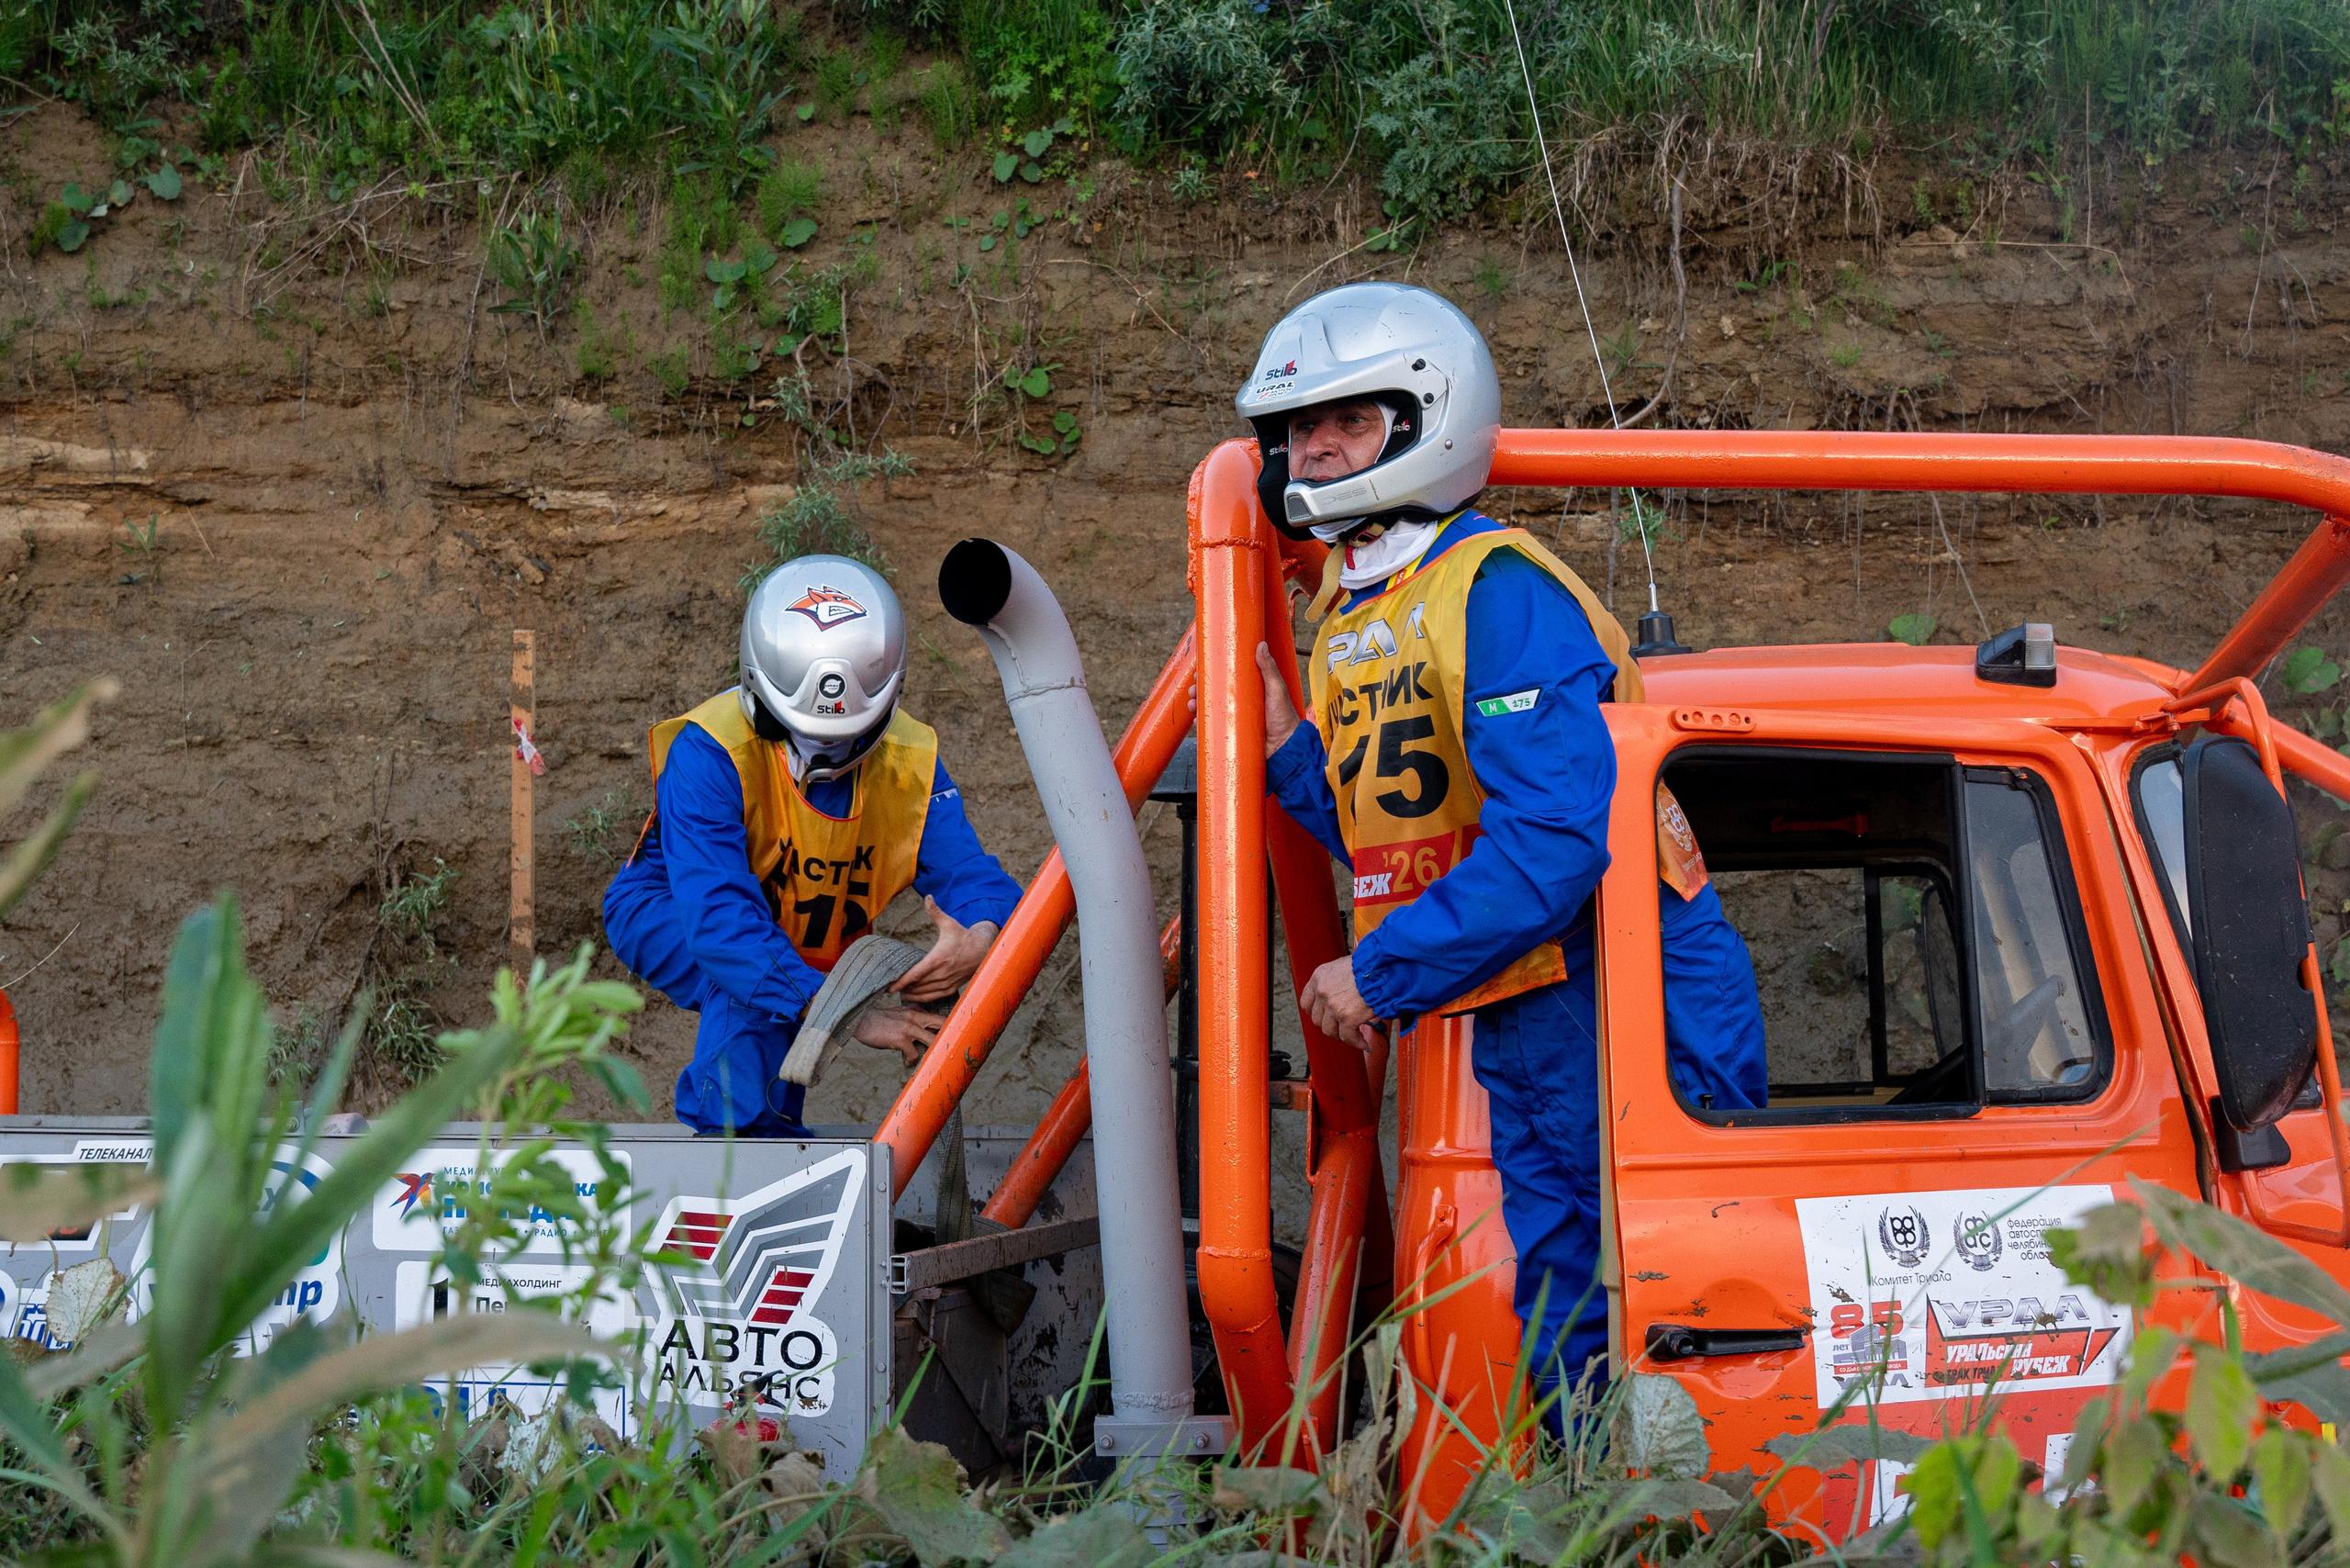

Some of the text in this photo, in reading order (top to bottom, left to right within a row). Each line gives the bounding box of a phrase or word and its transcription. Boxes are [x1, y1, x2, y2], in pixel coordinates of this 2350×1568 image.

[1265, 360, 1297, 380] Stilo
[1257, 382, 1293, 394] URAL
[1327, 601, 1426, 676] РАЛ
[817, 700, 845, 714] Stilo
[1512, 699, 1531, 708] 175
[79, 1148, 153, 1159] ТЕЛЕКАНАЛ
[2007, 1217, 2062, 1229] федерация
[2009, 1229, 2048, 1239] автоспо
[2007, 1238, 2053, 1249] челябинс
[476, 1278, 563, 1289] МЕДИАХОЛДИНГ
[1871, 1271, 1952, 1287] Комитет Триала
[1940, 1294, 2090, 1328] УРАЛ
[1830, 1300, 1904, 1339] 85
[660, 1319, 822, 1371] АВТО
[1832, 1343, 1850, 1351] лет
[2010, 1355, 2071, 1378] РУБЕЖ
